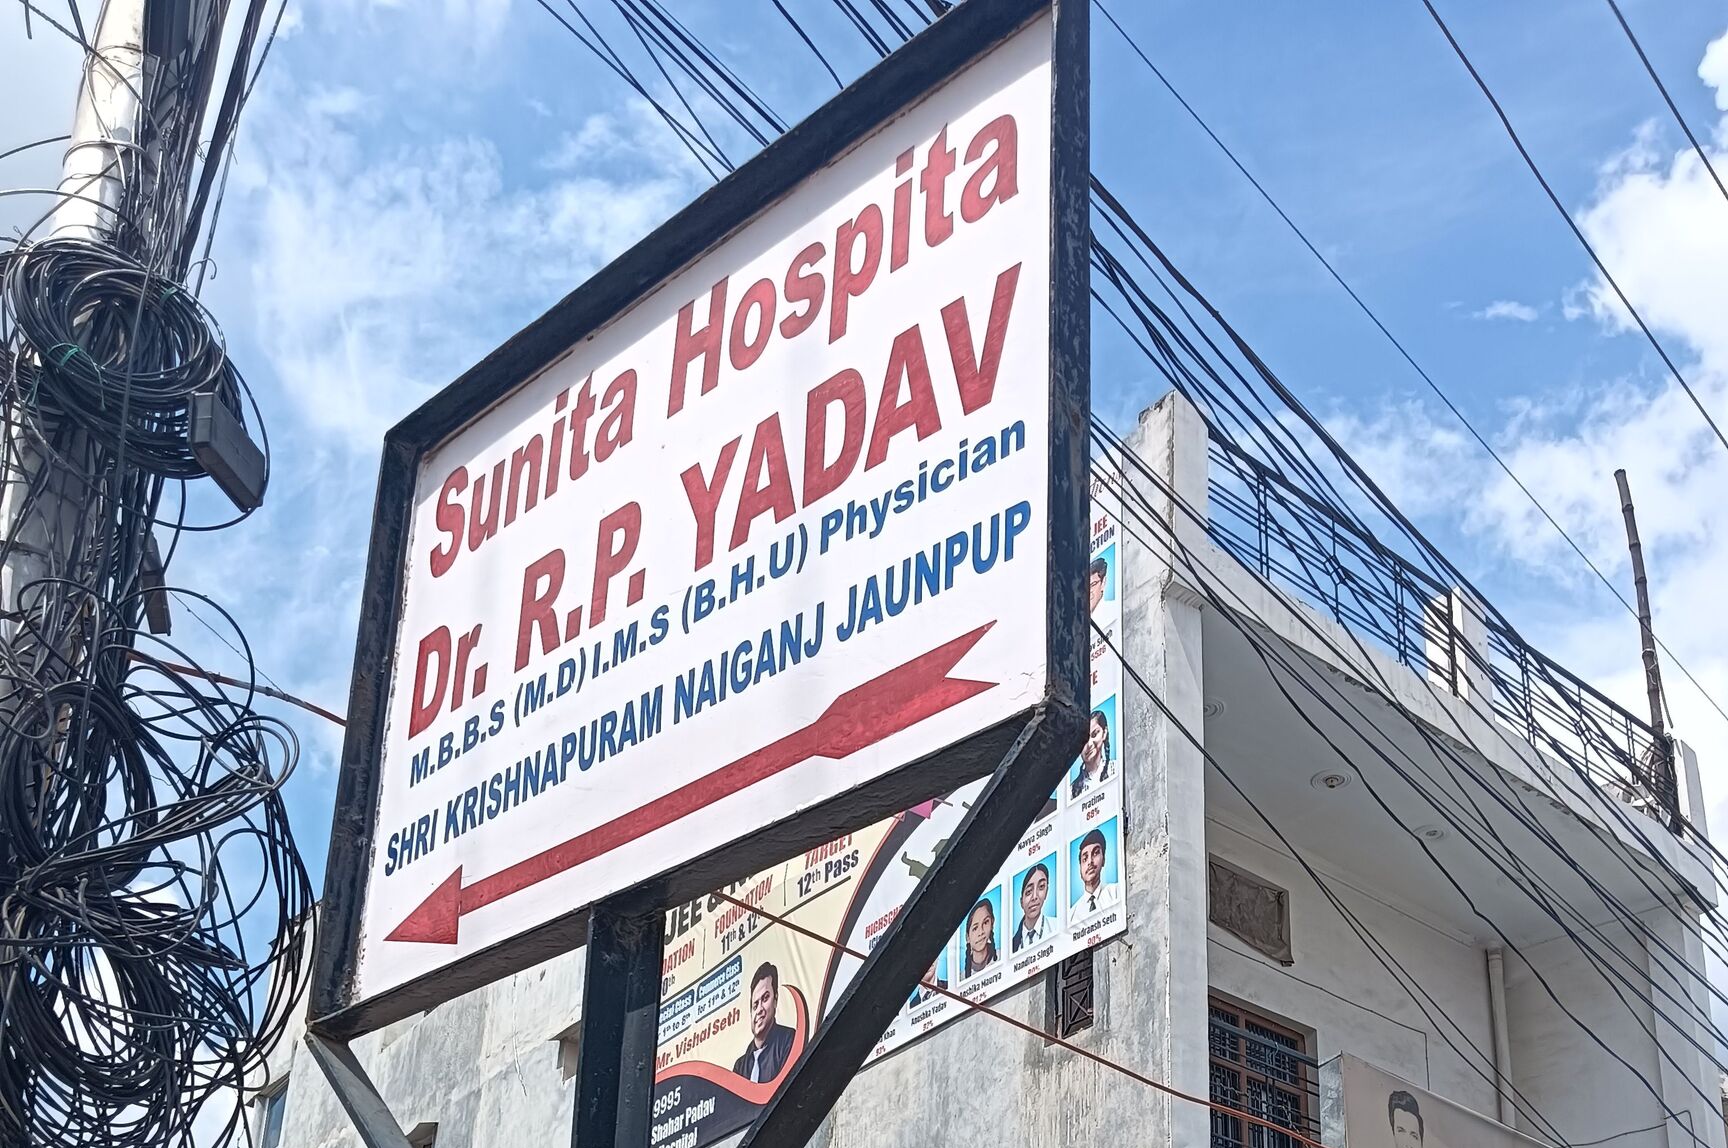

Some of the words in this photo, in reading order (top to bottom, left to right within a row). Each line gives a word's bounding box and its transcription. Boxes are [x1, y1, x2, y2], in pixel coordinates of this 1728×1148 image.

[430, 369, 638, 581] Sunita
[667, 113, 1019, 419] Hospita
[408, 624, 488, 741] Dr.
[514, 502, 646, 674] R.P.
[681, 261, 1022, 573] YADAV
[1089, 524, 1115, 554] CTION
[1093, 513, 1108, 537] JEE
[410, 699, 505, 788] M.B.B.S
[682, 523, 808, 634] (B.H.U)
[819, 419, 1026, 555] Physician
[384, 808, 438, 877] SHRI
[444, 684, 663, 845] KRISHNAPURAM
[673, 600, 824, 725] NAIGANJ
[1081, 792, 1105, 812] Pratima
[797, 868, 822, 898] 12th
[824, 849, 860, 884] Pass
[664, 899, 703, 946] JEE
[1101, 912, 1117, 927] Seth
[662, 937, 696, 976] DATION
[661, 974, 676, 997] 0th
[675, 1023, 711, 1059] Vishal
[712, 1007, 741, 1036] Seth
[651, 1113, 685, 1145] Shahar
